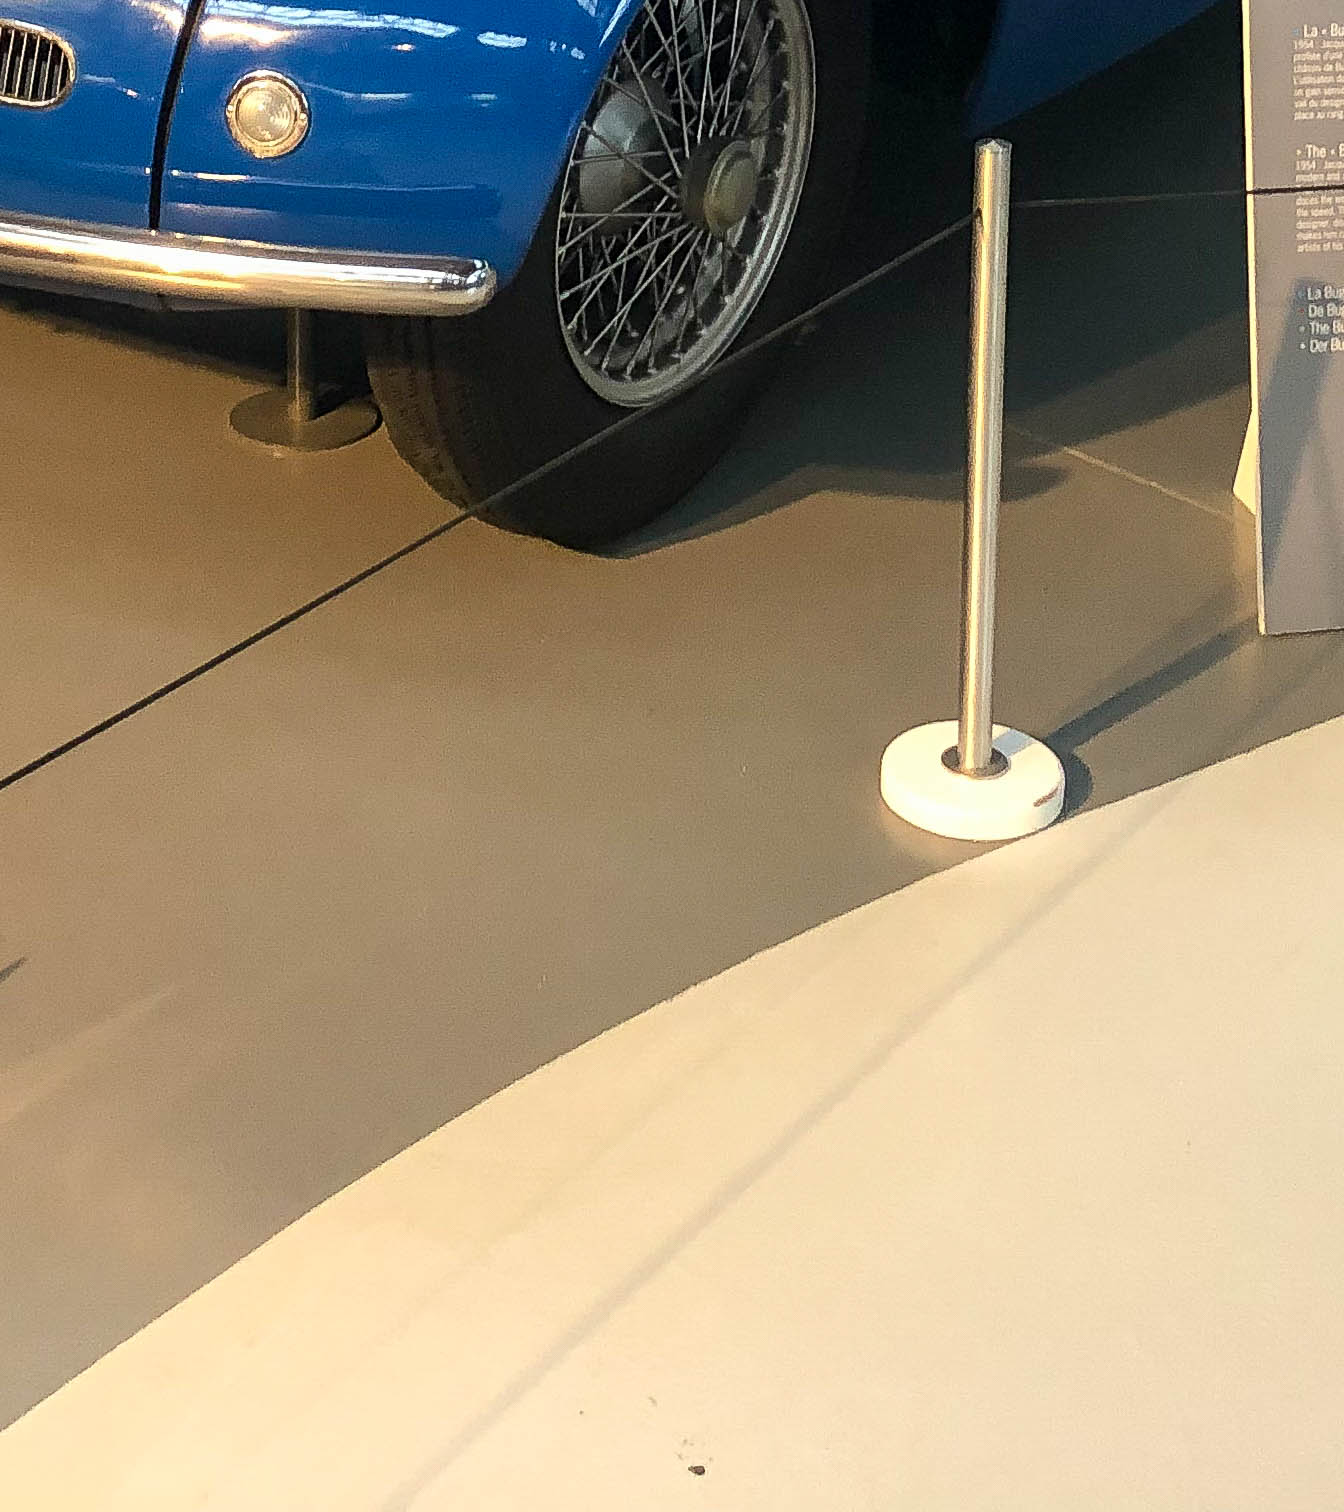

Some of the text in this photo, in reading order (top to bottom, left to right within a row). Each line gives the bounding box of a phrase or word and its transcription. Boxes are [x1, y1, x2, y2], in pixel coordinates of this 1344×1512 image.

[1303, 24, 1318, 37] La
[1307, 144, 1326, 158] The
[1307, 287, 1322, 301] La
[1308, 304, 1324, 318] De
[1310, 322, 1330, 335] The
[1309, 340, 1328, 353] Der
